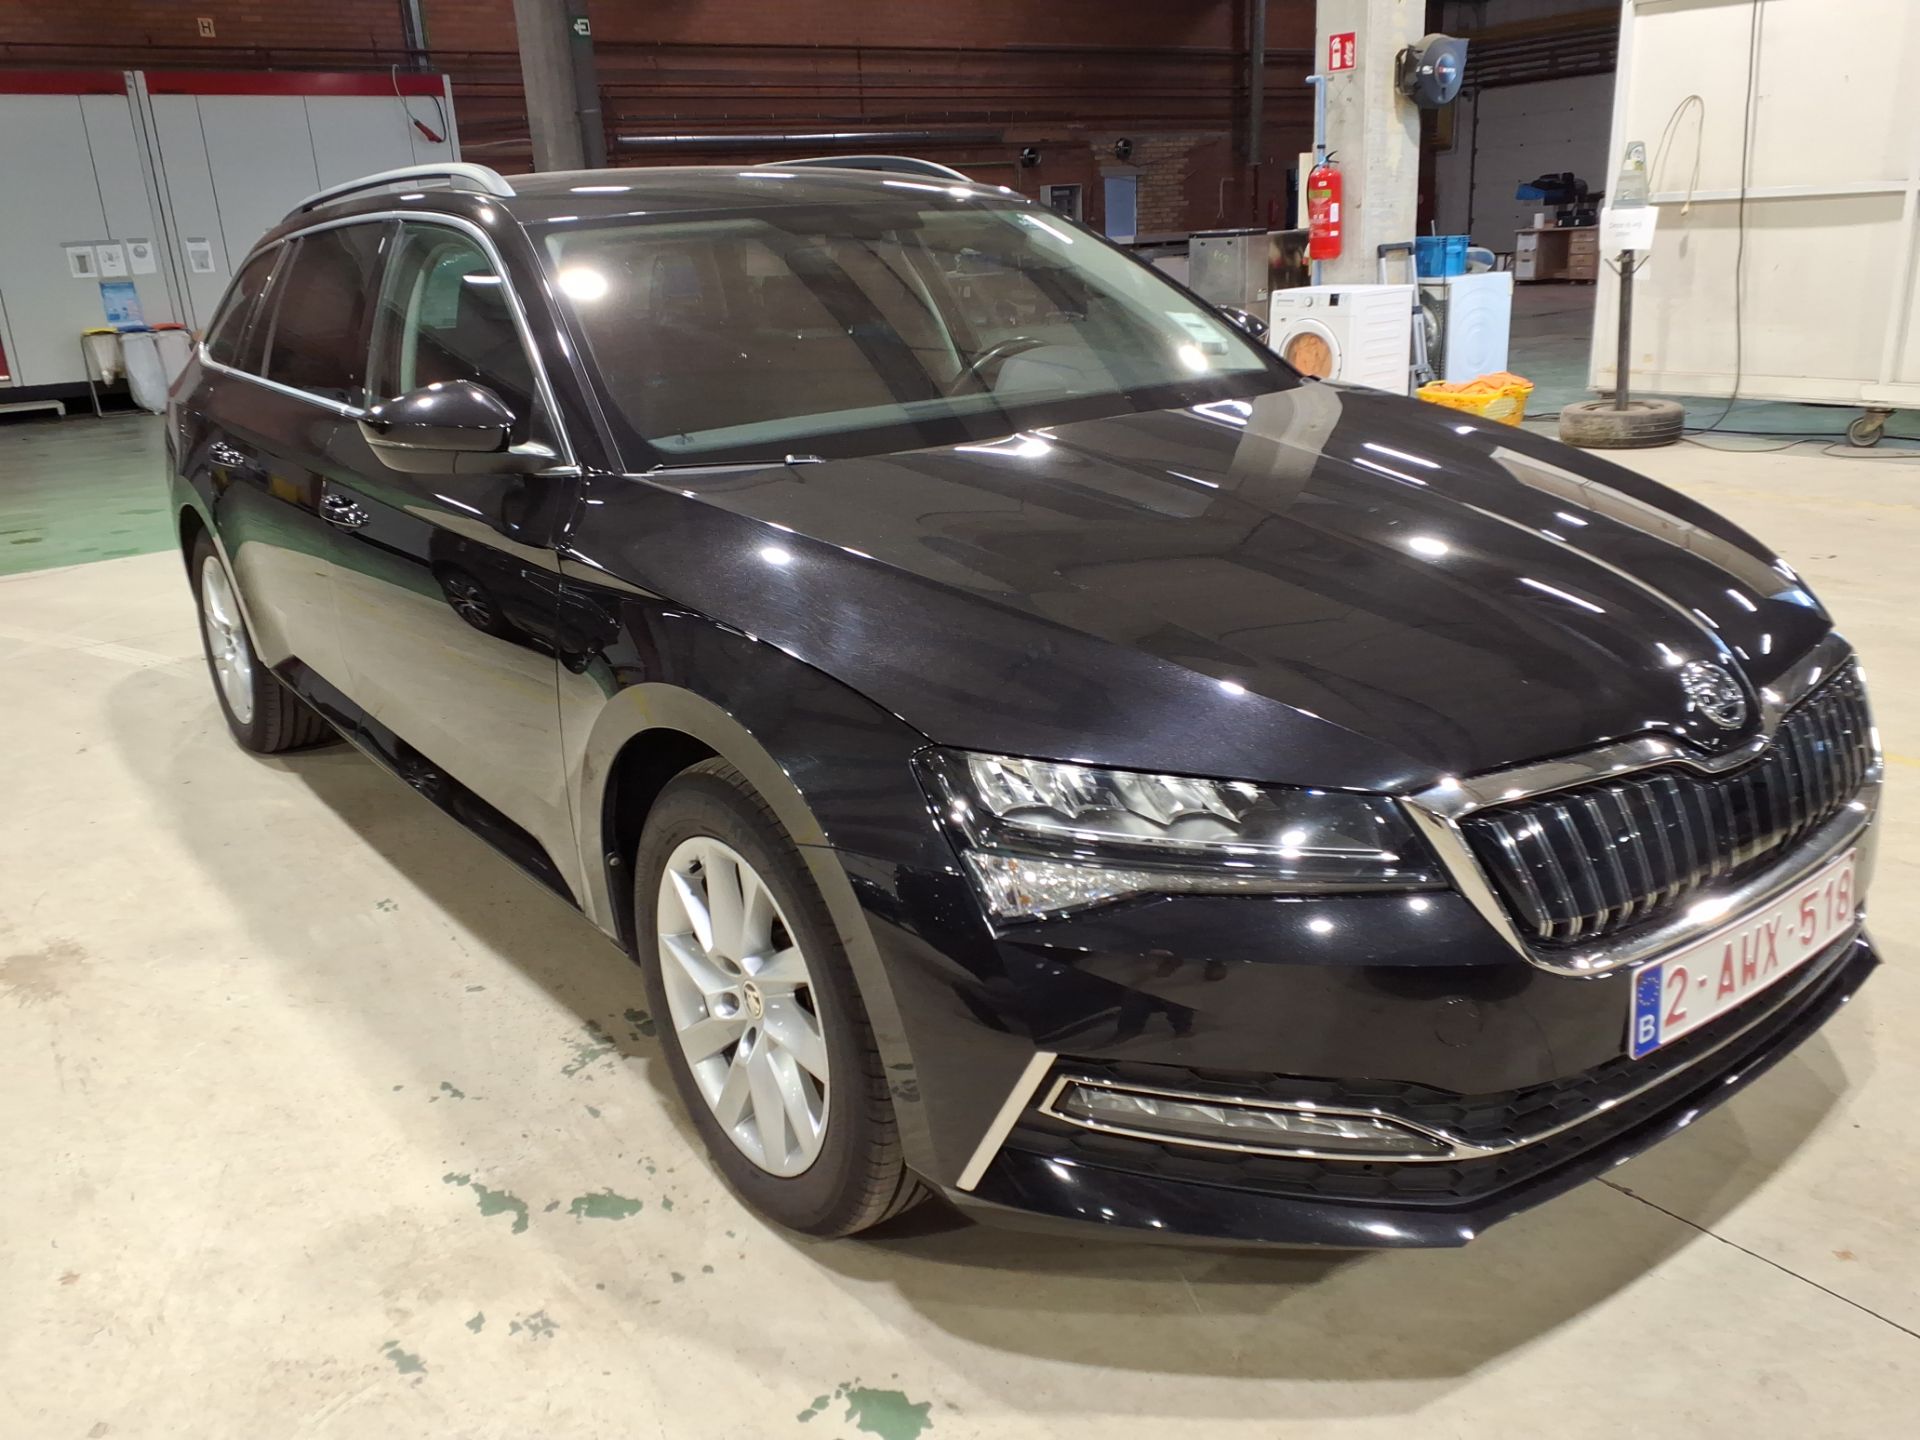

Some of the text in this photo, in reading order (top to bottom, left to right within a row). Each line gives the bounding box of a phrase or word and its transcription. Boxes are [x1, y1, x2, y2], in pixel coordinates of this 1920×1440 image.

[200, 20, 212, 34] H
[1664, 869, 1850, 1028] 2-AWX-518
[1638, 1014, 1656, 1044] B
